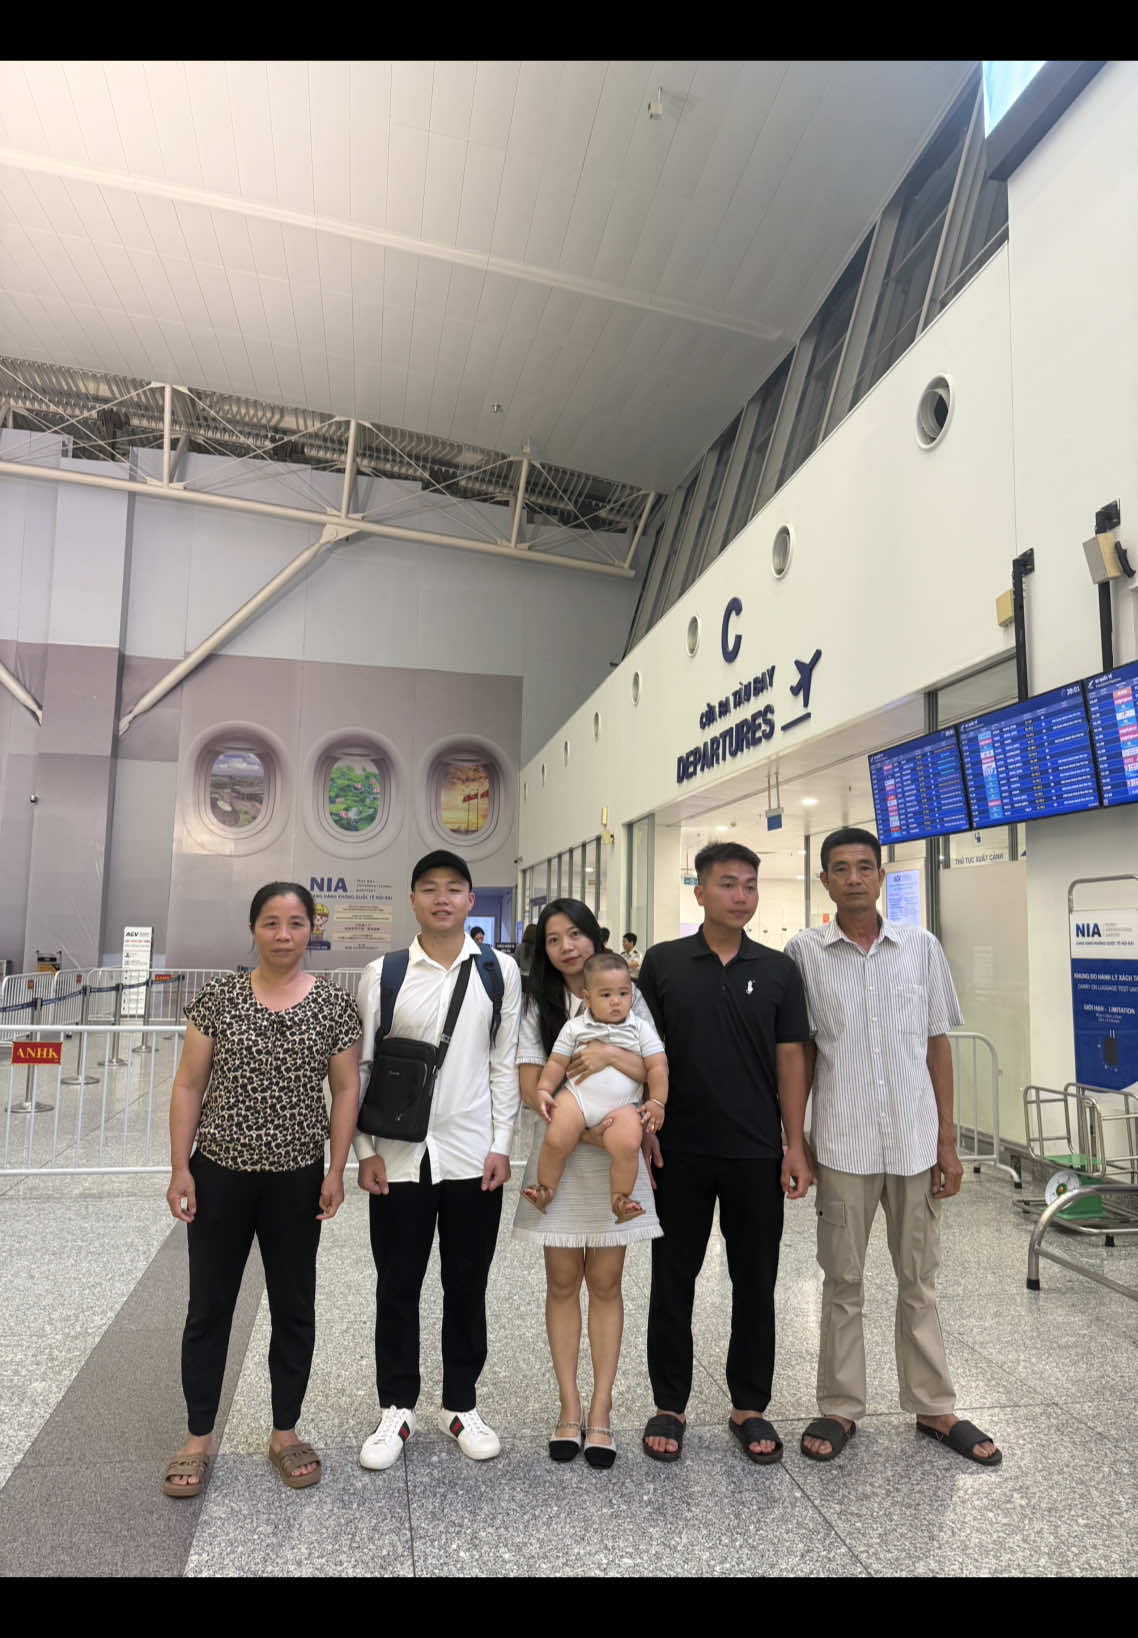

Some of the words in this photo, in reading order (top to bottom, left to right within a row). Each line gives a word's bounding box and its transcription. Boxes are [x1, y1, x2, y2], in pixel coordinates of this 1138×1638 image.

[721, 597, 743, 664] C
[732, 681, 752, 710] TÀU
[753, 665, 776, 698] BAY
[677, 704, 775, 784] DEPARTURES
[310, 877, 348, 892] NIA
[1075, 923, 1101, 937] NIA
[17, 1047, 59, 1059] ANHK
